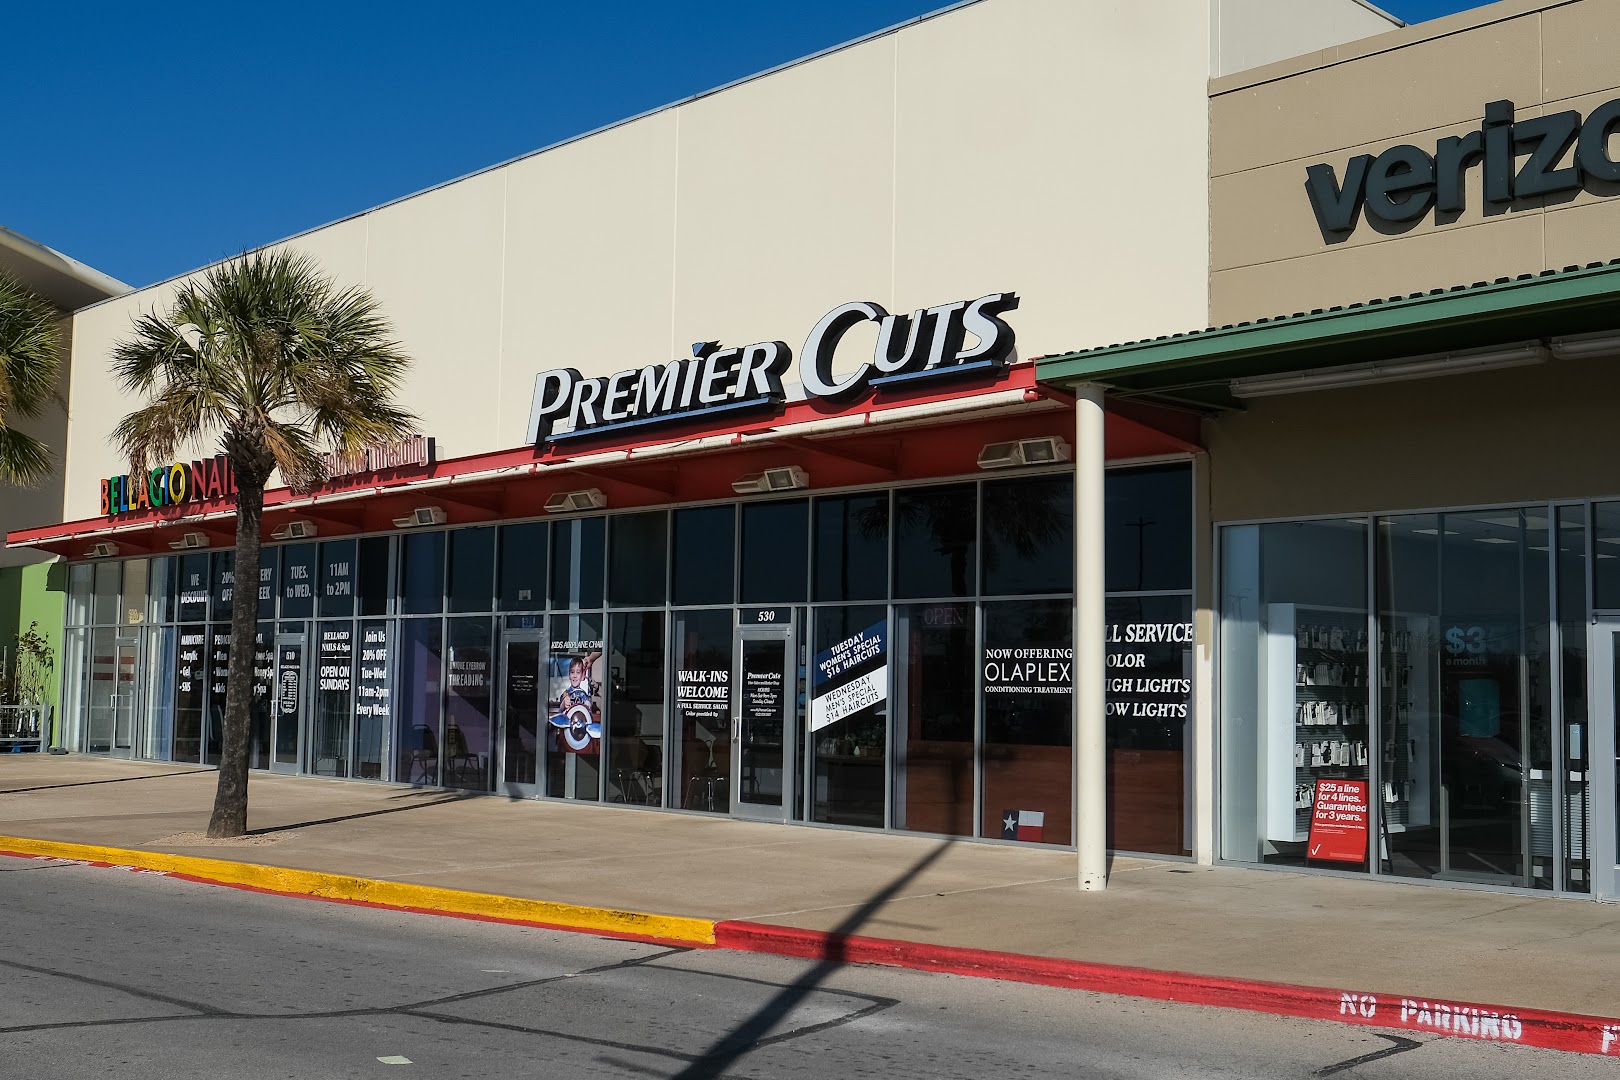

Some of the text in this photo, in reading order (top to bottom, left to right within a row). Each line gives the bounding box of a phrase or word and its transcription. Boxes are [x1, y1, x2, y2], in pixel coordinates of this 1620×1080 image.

[1304, 98, 1620, 245] verizo
[525, 291, 1020, 446] PREMIER CUTS
[101, 454, 239, 515] BELLAGIO NAIL
[260, 568, 273, 582] ERY
[290, 566, 309, 579] TUES.
[329, 562, 349, 576] 11AM
[190, 573, 200, 586] WE
[221, 571, 235, 584] 20%
[222, 588, 233, 602] OFF
[258, 586, 271, 600] EEK
[286, 584, 311, 598] to WED.
[326, 581, 350, 595] to 2PM
[180, 590, 208, 604] DISCOUNT
[757, 611, 775, 622] 530
[924, 607, 964, 625] OPEN
[323, 631, 350, 640] BELLAGIO
[365, 630, 386, 642] Join Us
[1105, 623, 1193, 642] LL SERVICE
[321, 643, 337, 651] NAILS
[551, 641, 564, 649] KIDS
[831, 632, 864, 655] TUESDAY
[1445, 625, 1487, 657] $3
[362, 649, 387, 660] 20% OFF
[819, 635, 881, 671] WOMEN'S SPECIAL
[985, 648, 1073, 659] NOW OFFERING
[827, 644, 880, 679] $16 HAIRCUTS
[1106, 653, 1146, 668] OLOR
[1453, 656, 1487, 666] month
[321, 665, 350, 677] OPEN ON
[361, 667, 387, 679] Tue-Wed
[678, 670, 729, 682] WALK-INS
[984, 662, 1071, 681] OLAPLEX
[320, 678, 350, 690] SUNDAYS
[448, 674, 484, 686] THREADING
[1105, 678, 1191, 693] IGH LIGHTS
[358, 686, 389, 700] 11am-2pm
[677, 686, 729, 698] WELCOME
[825, 675, 871, 702] WEDNESDAY
[825, 684, 876, 712] MEN'S SPECIAL
[356, 703, 390, 718] Every Week
[826, 691, 879, 723] $14 HAIRCUTS
[1106, 702, 1188, 718] OW LIGHTS
[1319, 783, 1337, 792] $25
[1343, 784, 1360, 793] line
[1318, 792, 1361, 803] for 4 lines.
[1317, 801, 1367, 812] Guaranteed
[1315, 811, 1362, 822] for 3 years.
[1340, 992, 1522, 1040] NO PARKING
